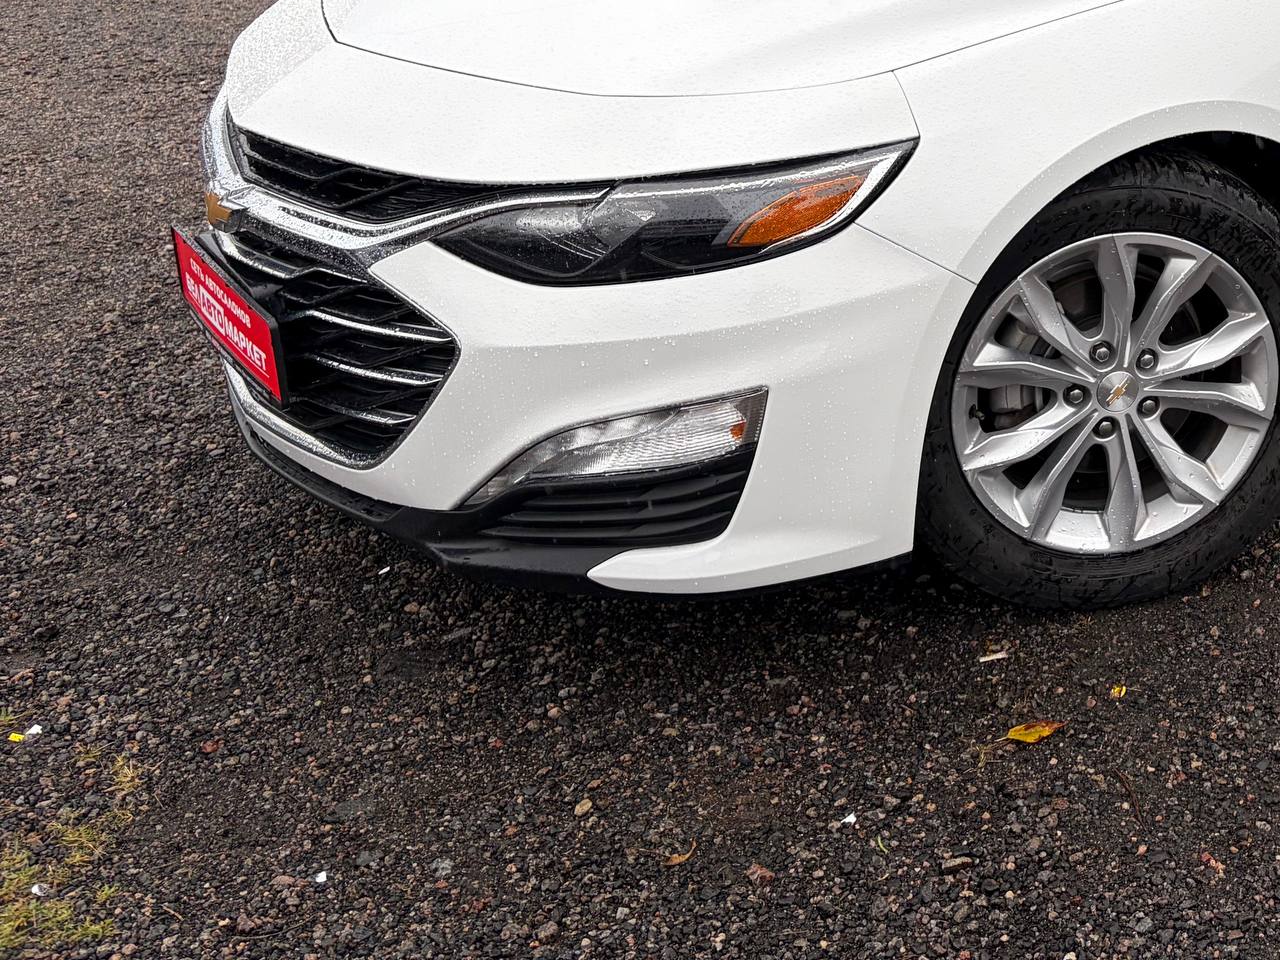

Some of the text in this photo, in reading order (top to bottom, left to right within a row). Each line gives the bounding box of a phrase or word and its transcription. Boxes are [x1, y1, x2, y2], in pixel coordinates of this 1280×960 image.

[185, 271, 268, 372] БЕЛ АВТО МАРКЕТ
[190, 257, 252, 329] СЕТЬ АВТОСАЛОНОВ
